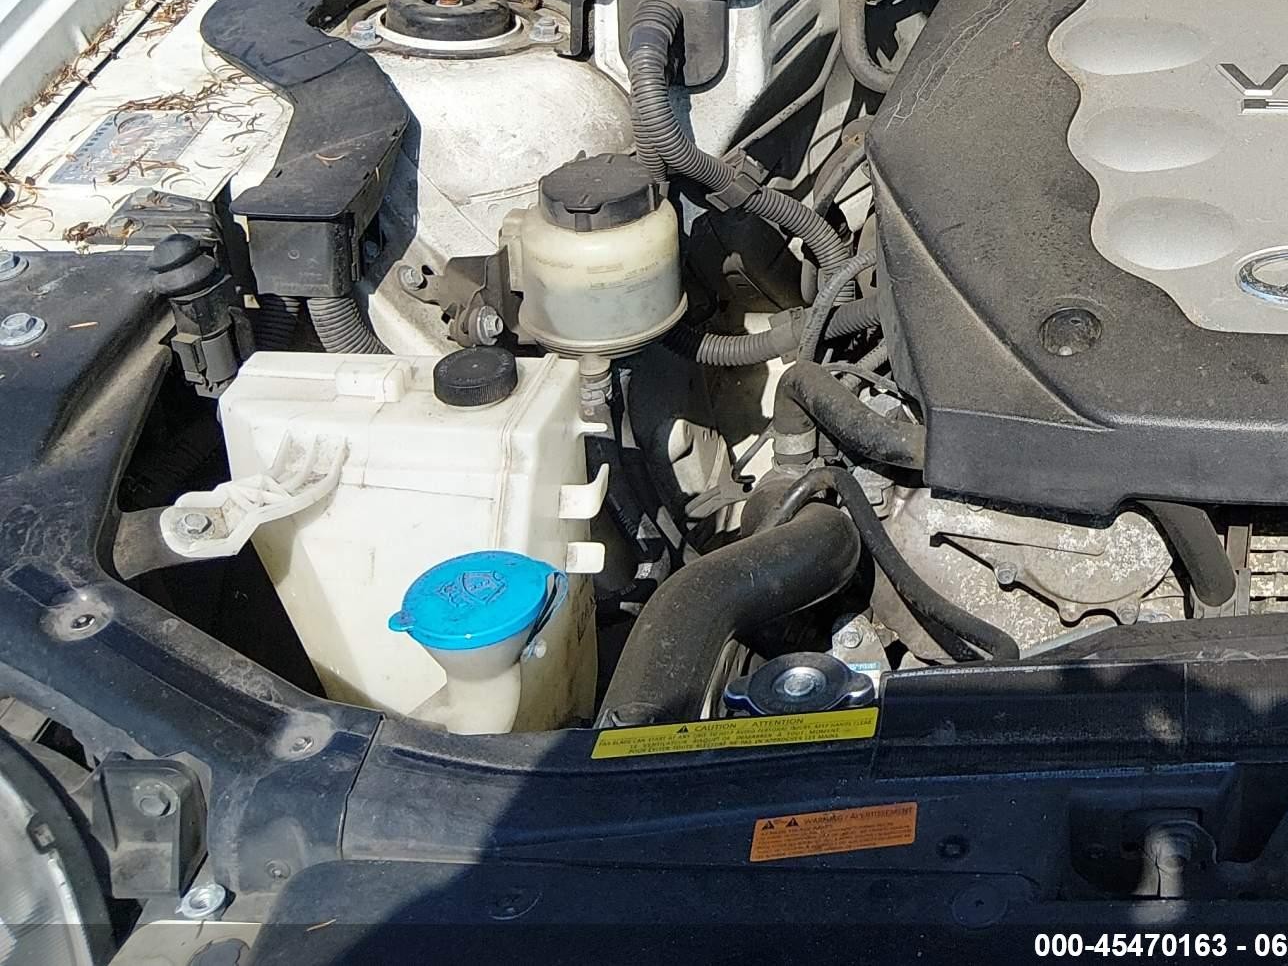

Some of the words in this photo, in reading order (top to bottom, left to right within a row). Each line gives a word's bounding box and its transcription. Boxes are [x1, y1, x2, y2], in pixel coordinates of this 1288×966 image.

[694, 722, 737, 732] CAUTION
[751, 718, 804, 728] ATTENTION
[803, 814, 843, 825] WARNING
